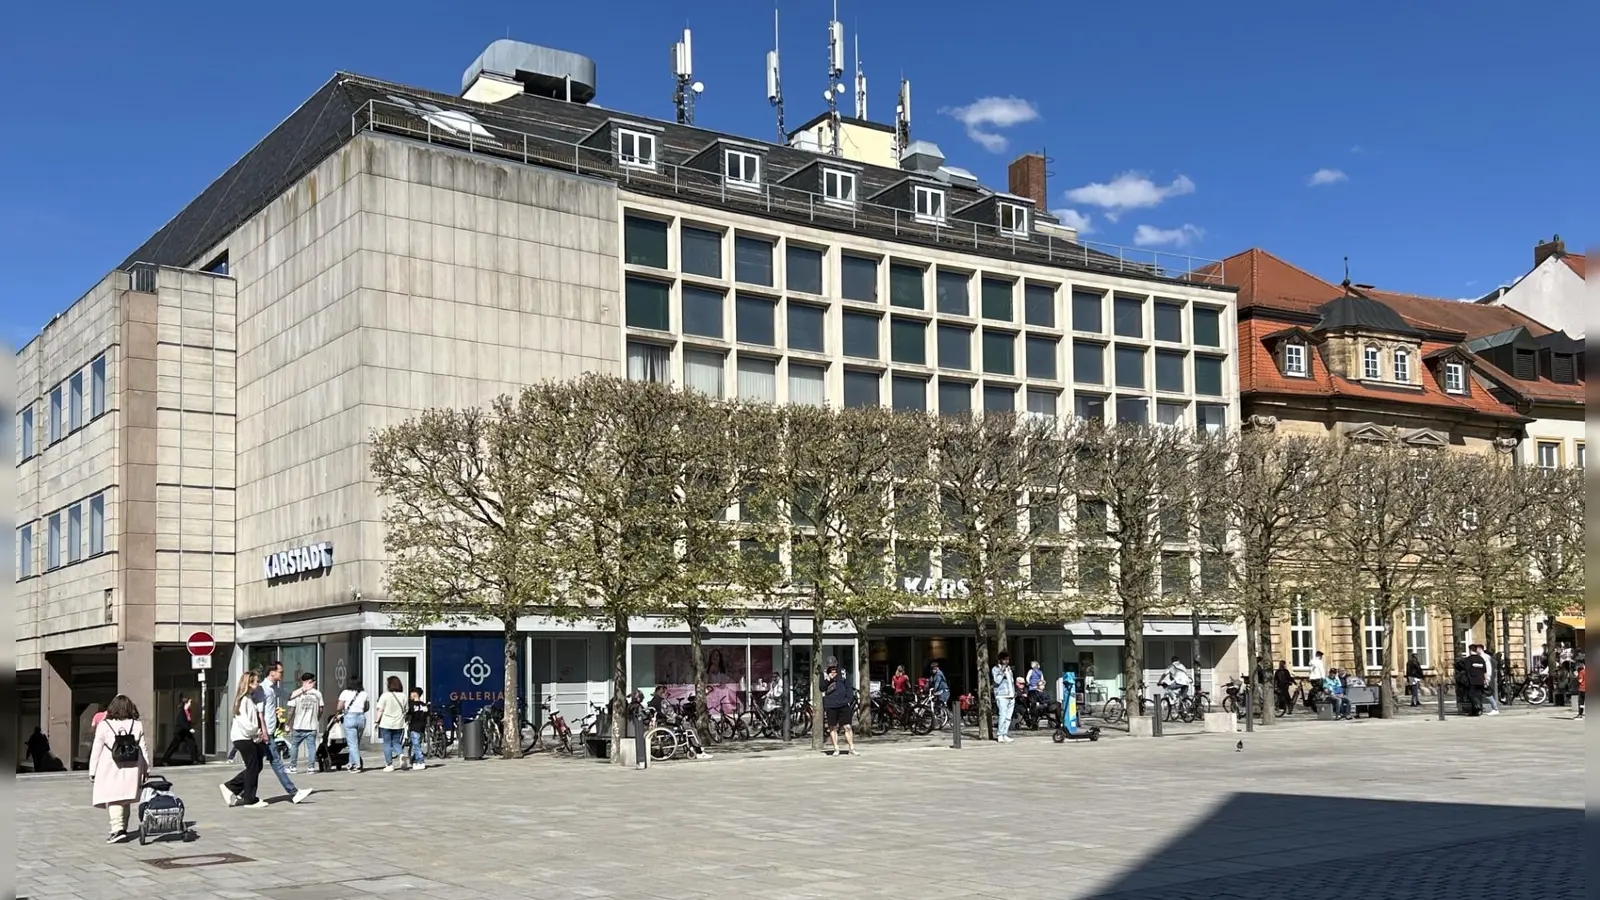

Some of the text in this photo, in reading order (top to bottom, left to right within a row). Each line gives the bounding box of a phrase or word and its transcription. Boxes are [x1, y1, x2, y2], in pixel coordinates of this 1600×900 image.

[263, 542, 330, 579] KARSTADT
[904, 577, 1026, 600] KARS
[449, 691, 505, 701] GALERIA
